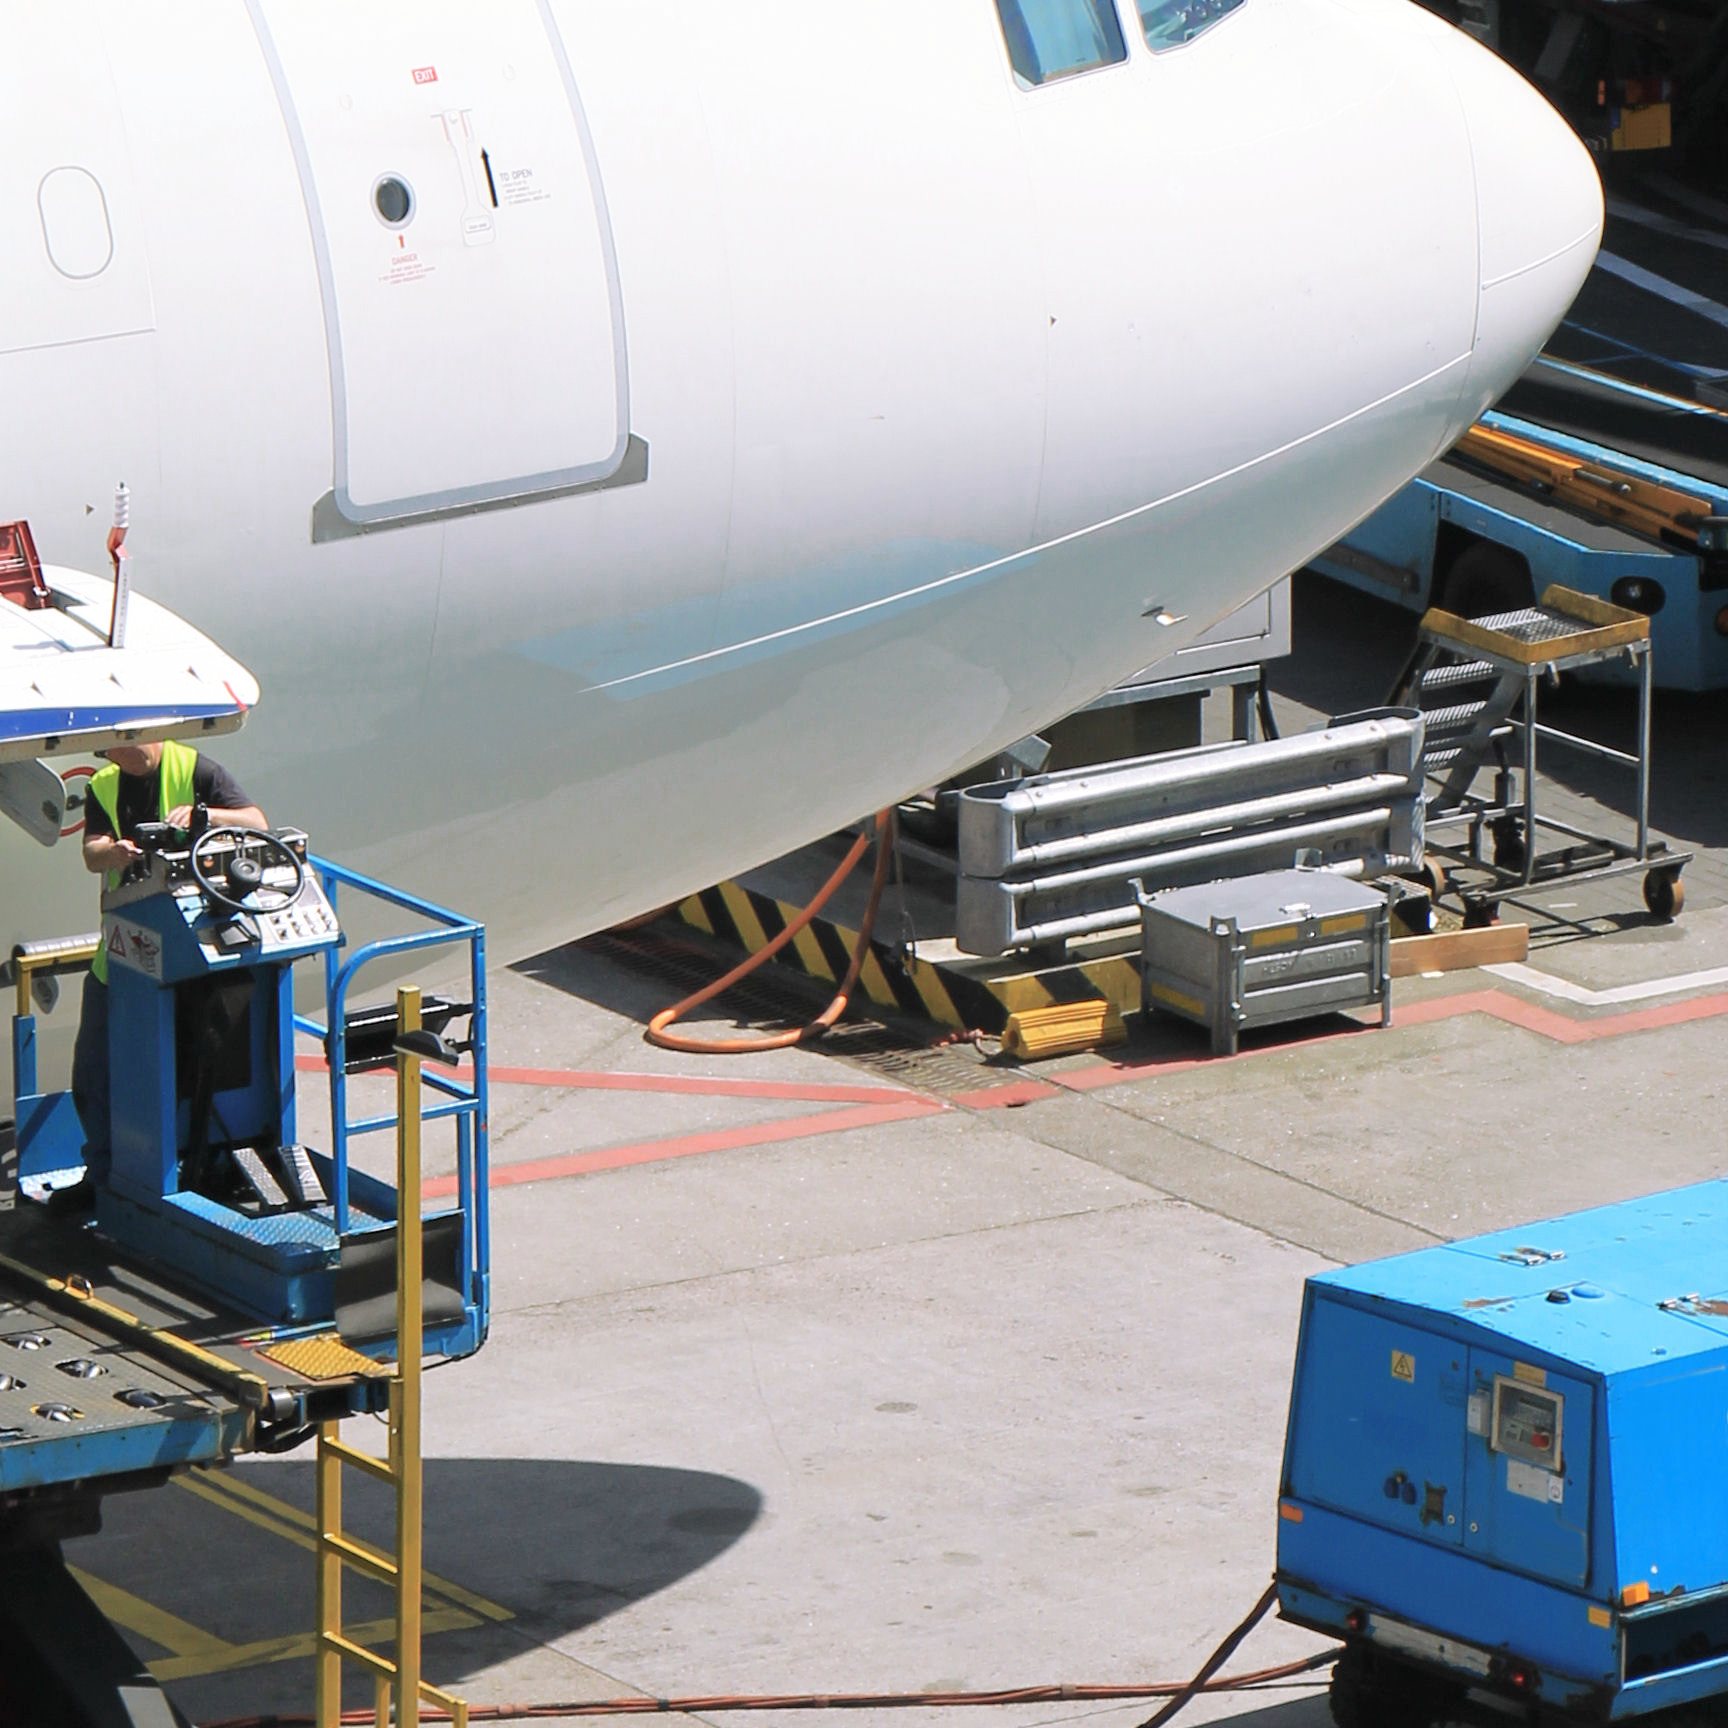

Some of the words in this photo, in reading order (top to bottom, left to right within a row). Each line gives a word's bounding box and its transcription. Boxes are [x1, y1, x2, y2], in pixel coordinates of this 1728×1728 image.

[414, 68, 435, 83] EXIT
[499, 172, 510, 182] TO
[511, 168, 533, 180] OPEN
[391, 253, 417, 264] DANGER
